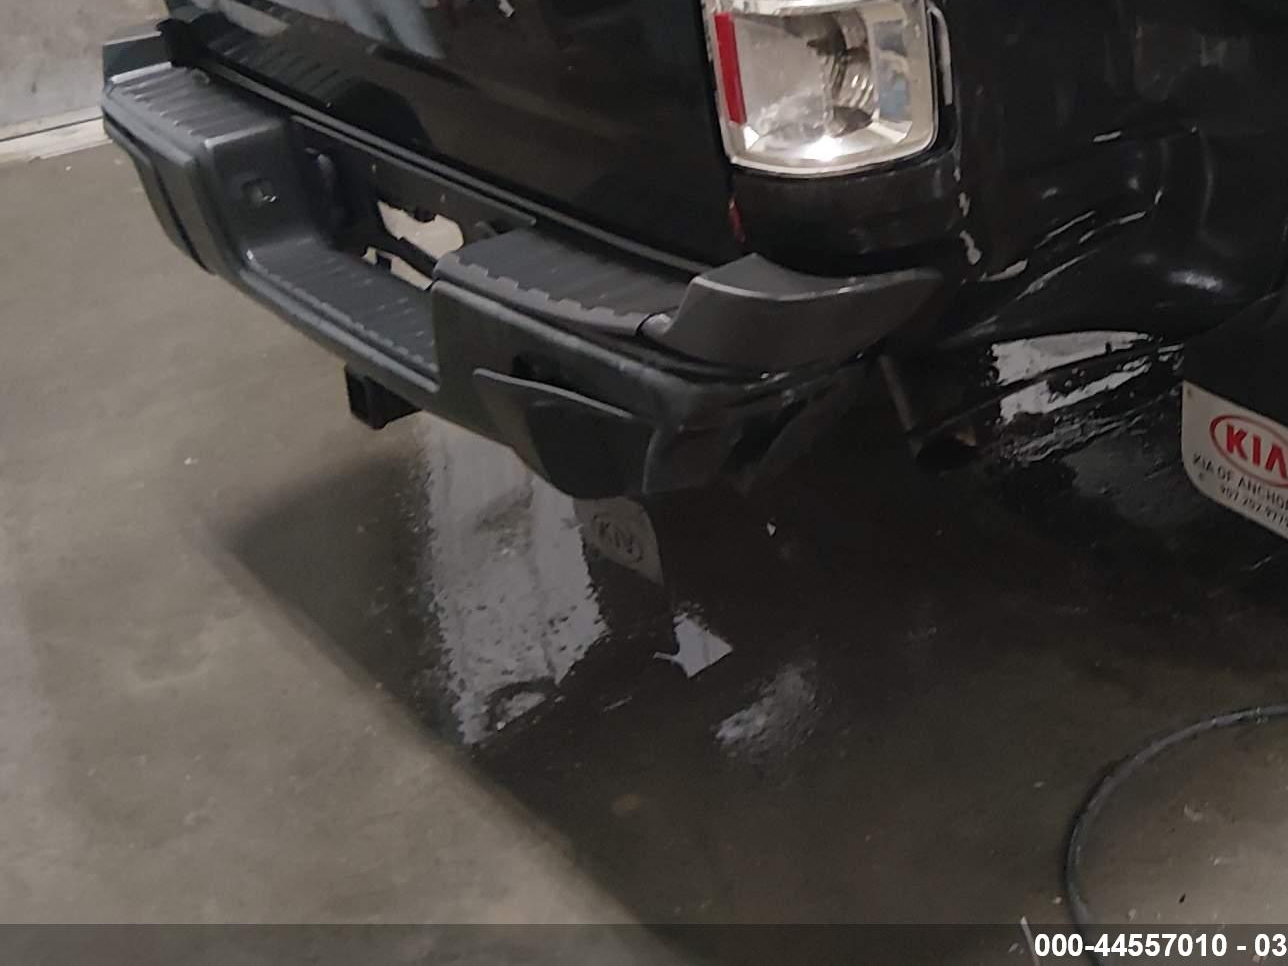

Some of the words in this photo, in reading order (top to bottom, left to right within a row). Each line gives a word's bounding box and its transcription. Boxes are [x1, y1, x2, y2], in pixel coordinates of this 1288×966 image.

[1193, 453, 1214, 471] KIA
[1217, 466, 1232, 482] OF
[1226, 424, 1288, 480] KIA
